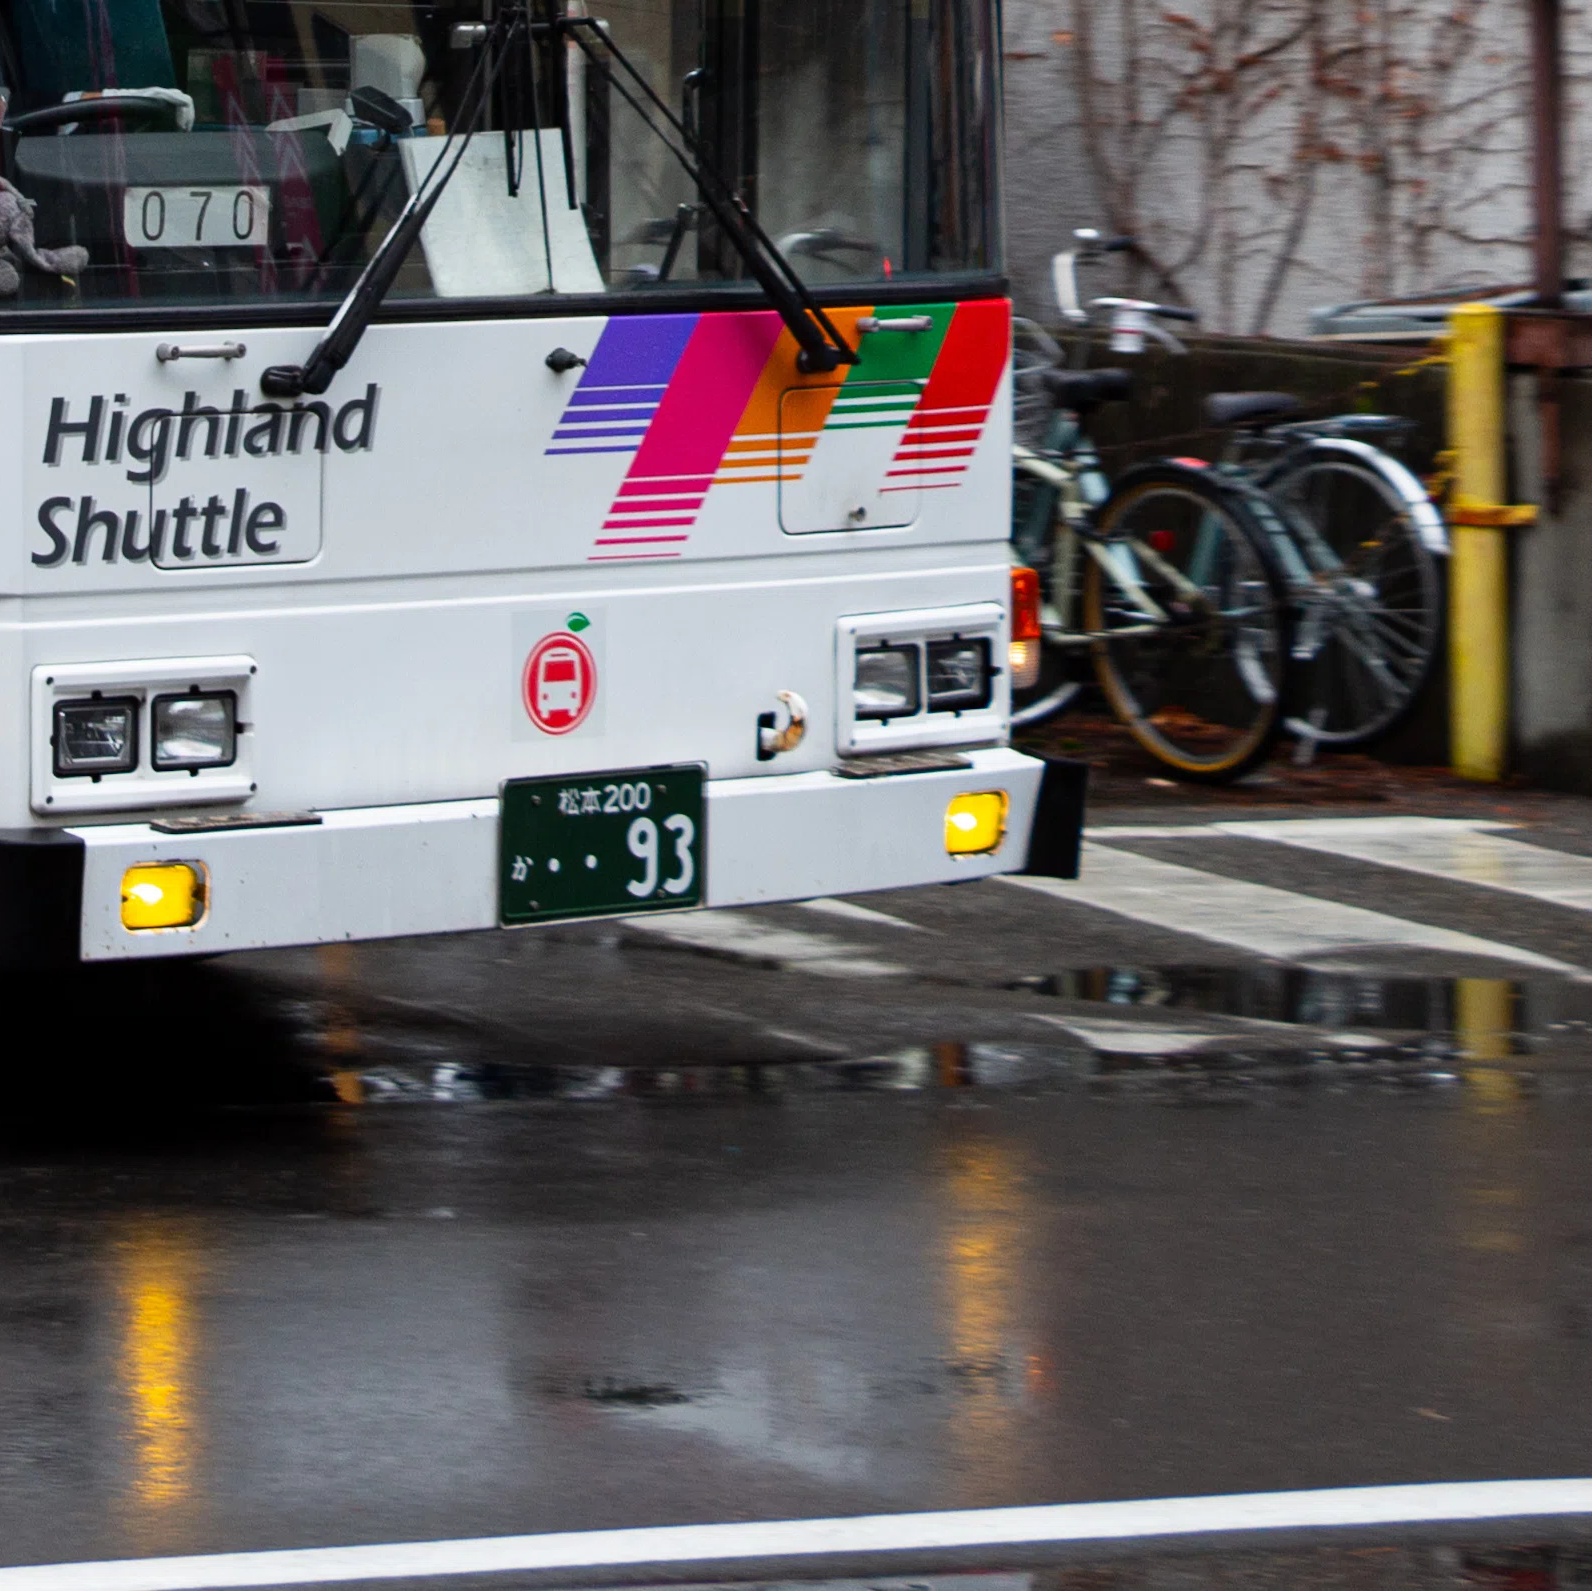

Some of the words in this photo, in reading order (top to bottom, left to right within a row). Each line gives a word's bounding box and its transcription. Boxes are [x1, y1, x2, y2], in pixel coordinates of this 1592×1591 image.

[142, 190, 255, 241] 070
[41, 383, 378, 484] Highland
[31, 488, 287, 569] Shuttle
